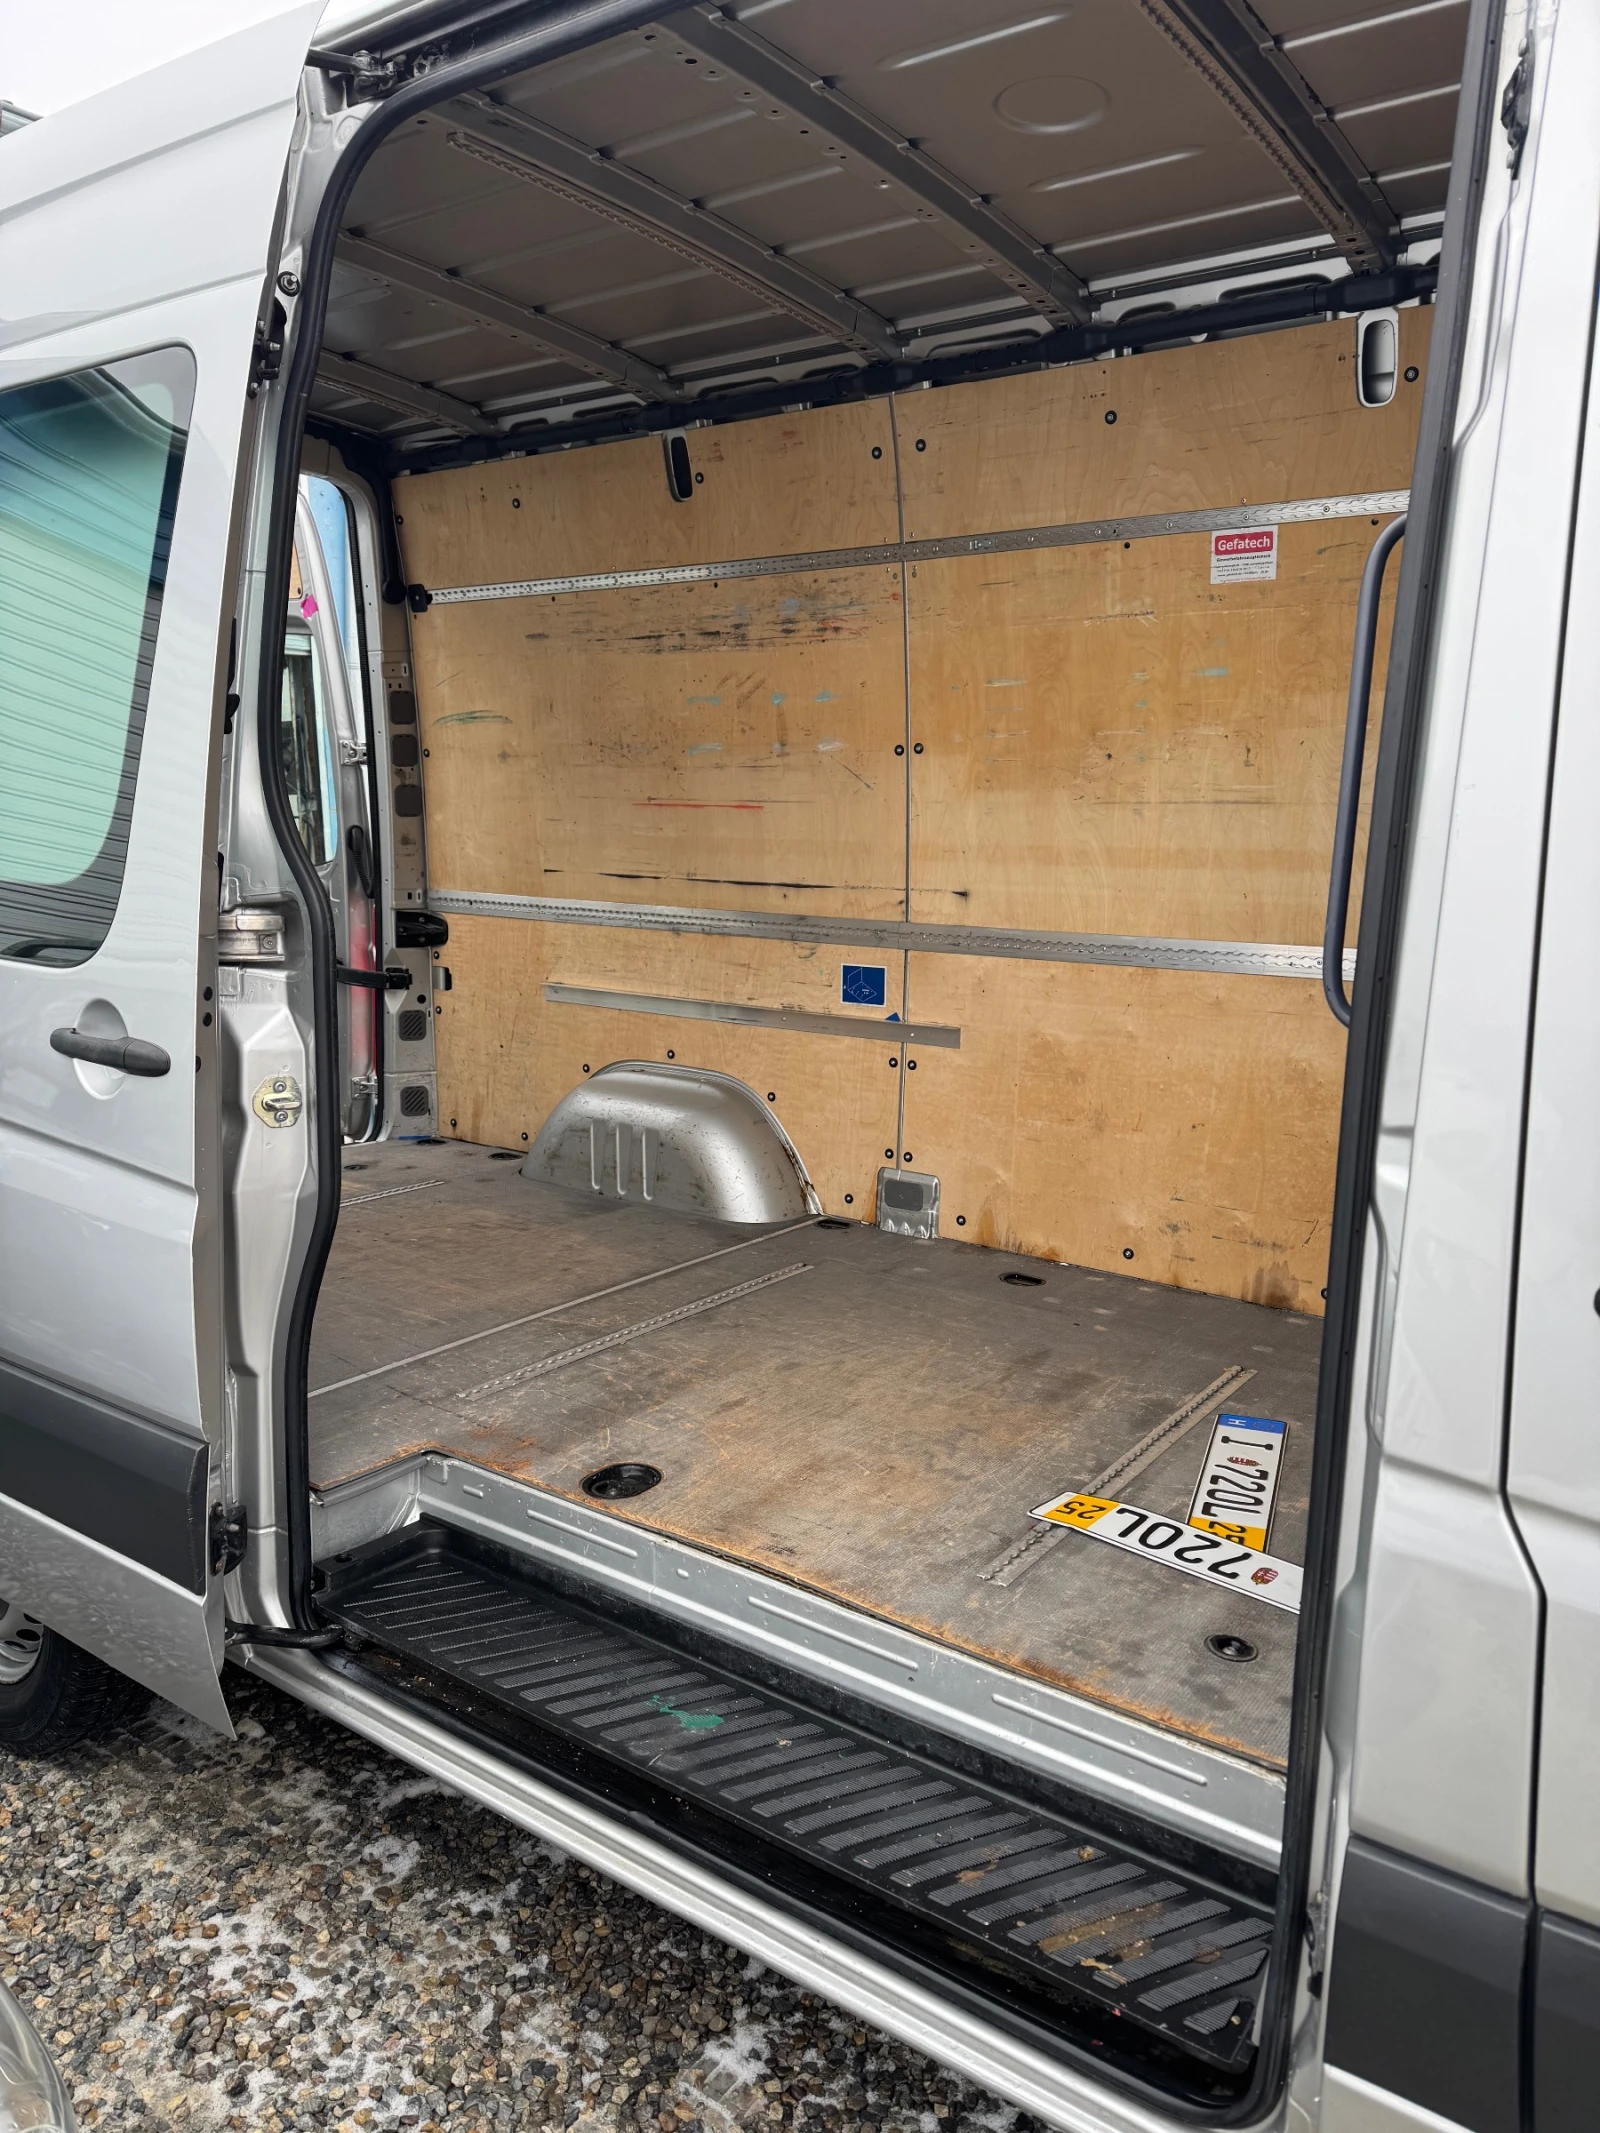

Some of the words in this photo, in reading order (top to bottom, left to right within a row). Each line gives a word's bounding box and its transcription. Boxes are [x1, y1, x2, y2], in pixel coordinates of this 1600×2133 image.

[1218, 536, 1270, 551] Gefatech
[1228, 1418, 1247, 1426] H
[1201, 1464, 1269, 1518] 720L
[1055, 1500, 1109, 1520] 25
[1116, 1507, 1254, 1580] 720L
